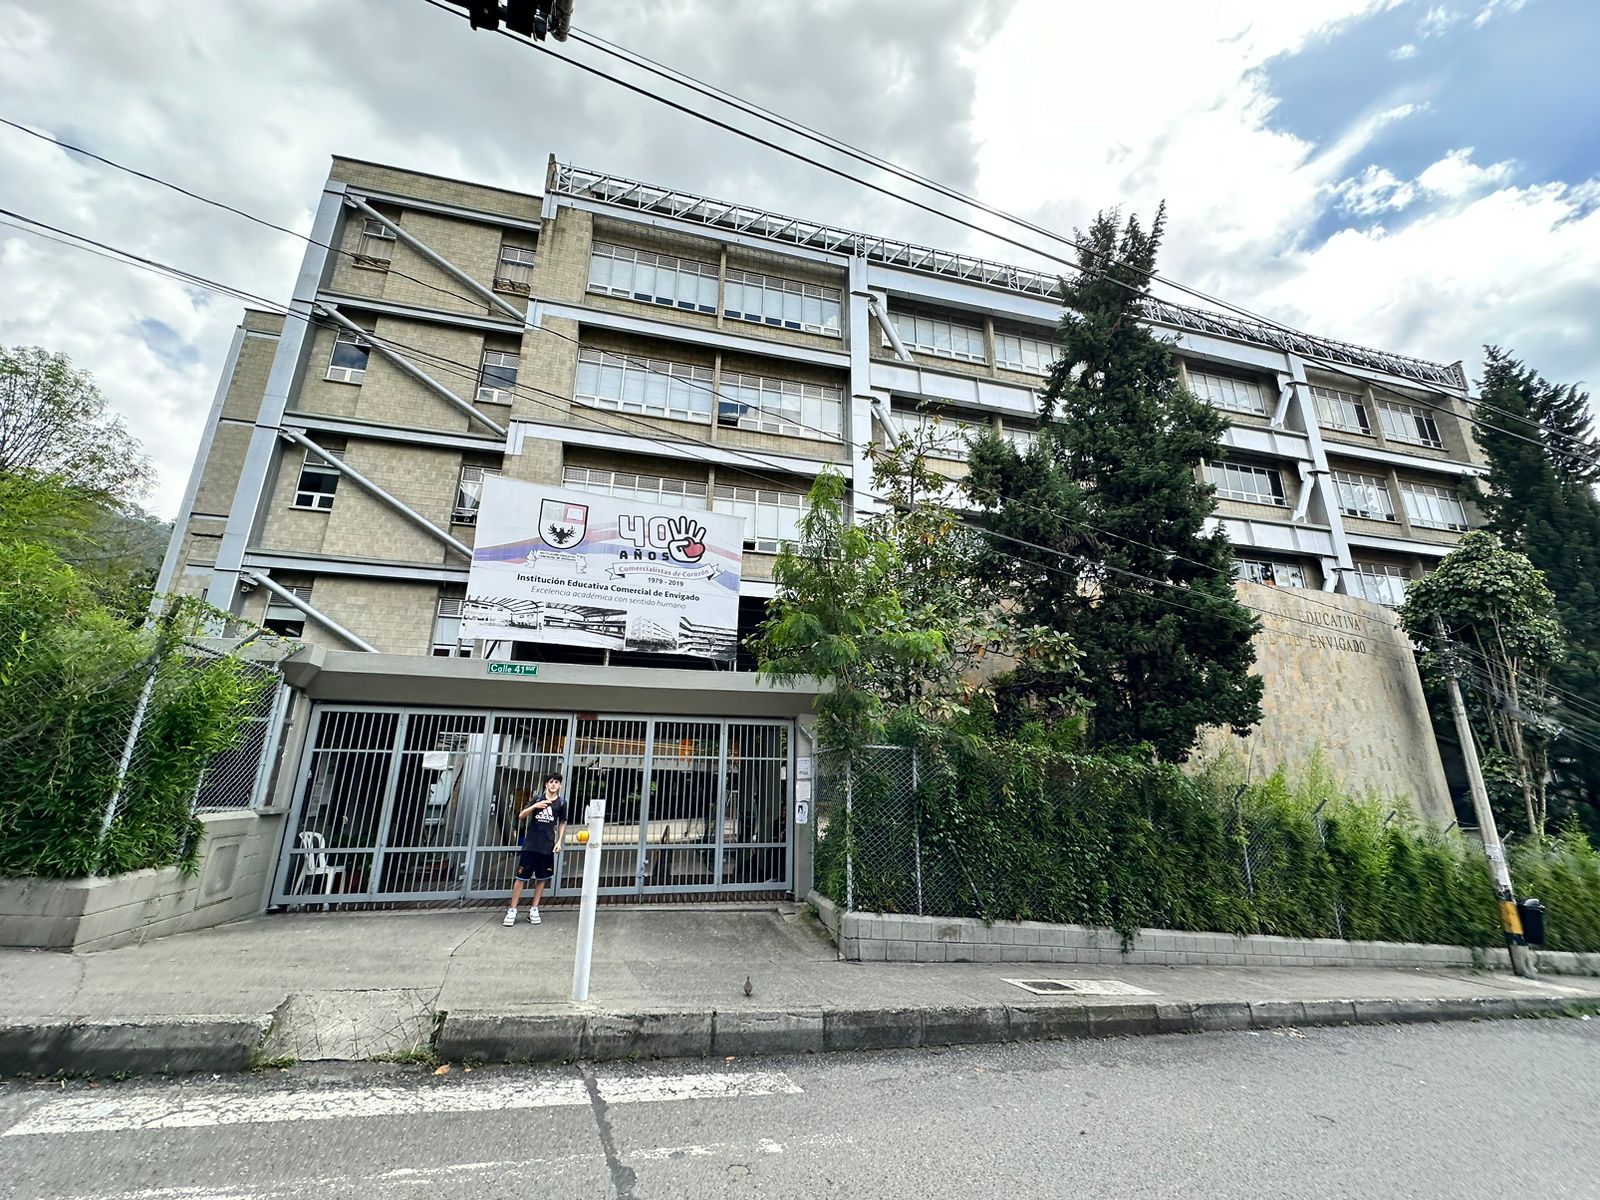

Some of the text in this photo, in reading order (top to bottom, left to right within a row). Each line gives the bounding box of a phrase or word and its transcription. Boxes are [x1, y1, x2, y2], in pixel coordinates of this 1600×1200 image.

[618, 515, 670, 549] 40
[619, 549, 670, 561] AÑOS
[618, 565, 671, 576] Comercialistas
[682, 569, 709, 578] Corazón
[647, 577, 663, 585] 1979
[668, 579, 684, 587] 2019
[517, 573, 700, 602] Institución Educativa Comercial de Envigado
[530, 585, 571, 597] Excelencia
[572, 591, 613, 601] académica
[629, 598, 656, 607] sentido
[656, 600, 687, 610] humano
[1298, 609, 1361, 631] EDUCATIVA
[1308, 633, 1366, 654] ENVIGADO
[490, 664, 512, 674] Calle
